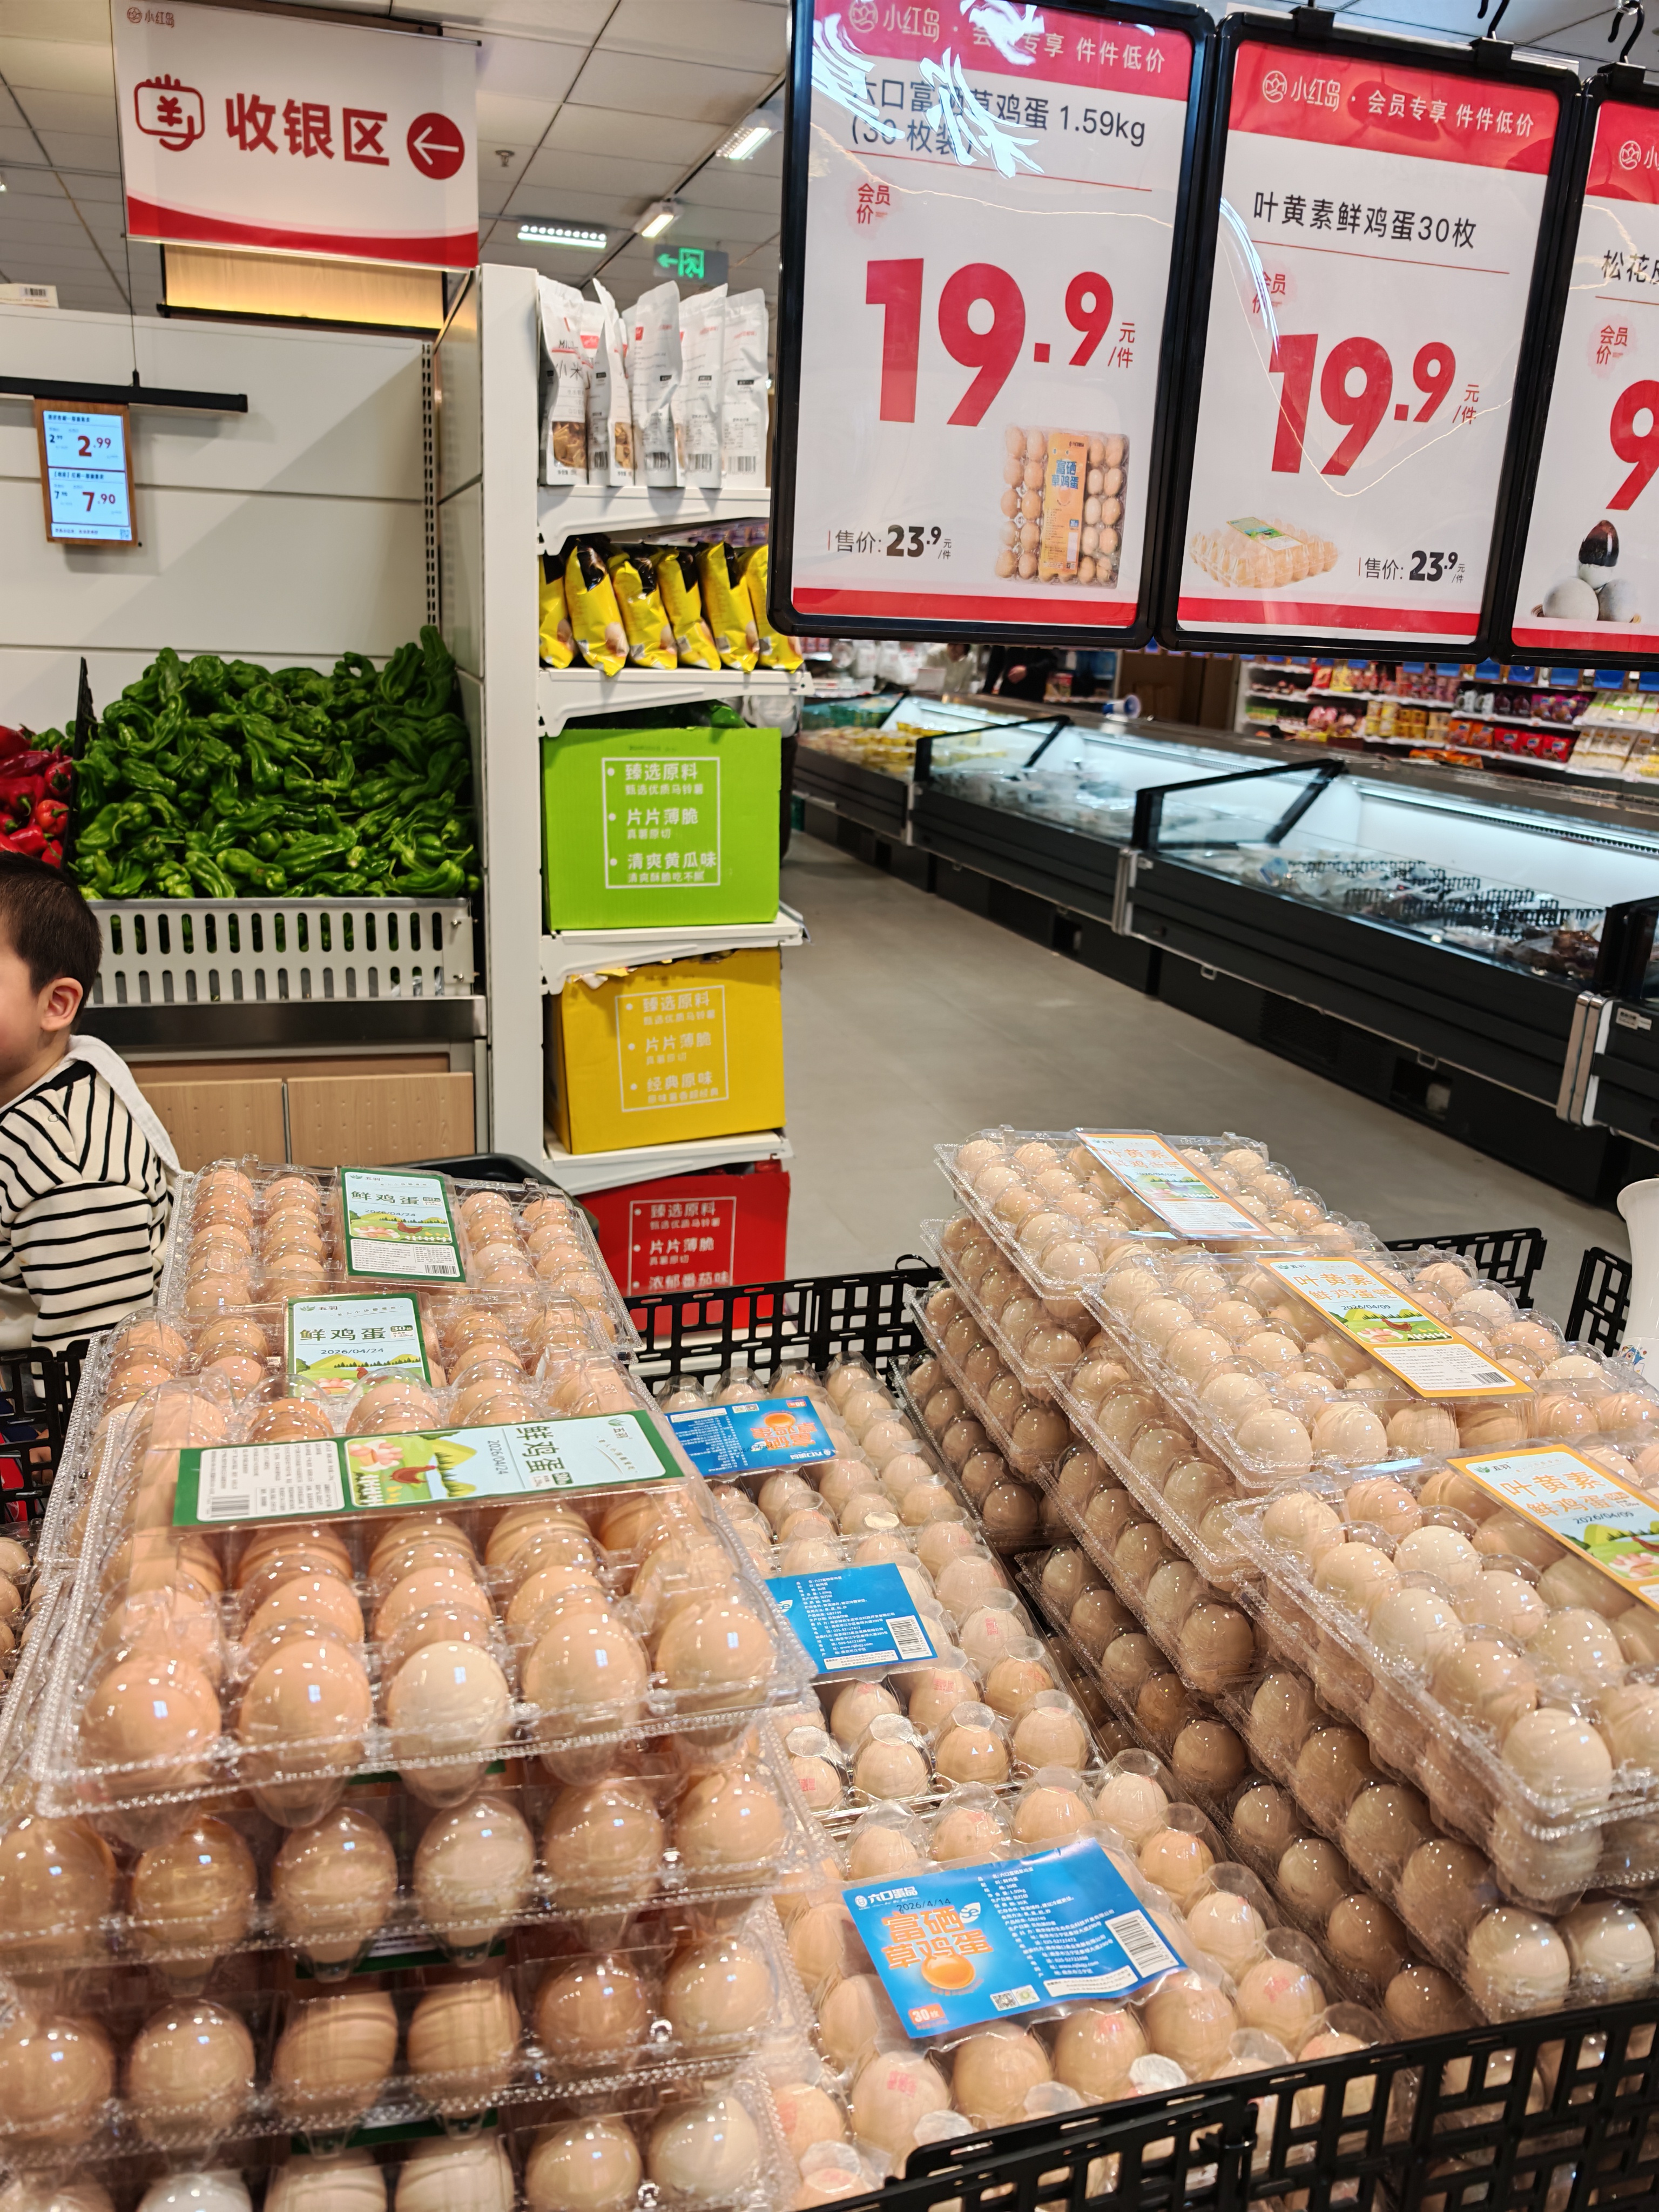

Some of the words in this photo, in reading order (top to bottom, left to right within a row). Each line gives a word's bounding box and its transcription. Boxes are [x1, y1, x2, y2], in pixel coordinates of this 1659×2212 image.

[144, 9, 174, 28] 小红岛
[883, 4, 940, 43] 小红岛
[973, 21, 1064, 58] 会专享
[1076, 36, 1166, 74] 件件低价
[1290, 78, 1340, 113] 小红岛
[1368, 90, 1447, 124] 会员专享
[1455, 103, 1534, 138] 件件低价
[225, 92, 390, 167] 收银区
[1059, 103, 1147, 147] 1.59kg
[1644, 145, 1659, 170] 小
[858, 183, 891, 207] 会员
[856, 204, 873, 225] 价
[1253, 191, 1476, 249] 叶黄素鲜鸡蛋30枚
[865, 258, 1113, 427] 19.9
[1120, 322, 1136, 342] 元
[1600, 324, 1628, 347] 会员
[1107, 346, 1134, 369] /件
[1596, 345, 1611, 365] 价
[1464, 383, 1480, 402] 元
[1268, 333, 1456, 477] 19.9
[885, 525, 942, 557] 23.9
[1408, 550, 1459, 582] 23.9
[625, 763, 698, 781] 臻选原料
[626, 807, 699, 826] 片片薄脆
[628, 852, 717, 870] 清爽黄瓜味
[643, 990, 710, 1013] 臻选原料
[645, 1031, 711, 1053] 片片薄脆
[647, 1070, 713, 1092] 经典原味
[351, 1191, 420, 1205] 鲜鸡蛋
[650, 1201, 716, 1219] 臻选原料
[649, 1237, 714, 1255] 片片薄脆
[1292, 1272, 1378, 1288] 叶黄素
[1309, 1288, 1376, 1301] 鲜鸡蛋
[299, 1327, 387, 1341] 鲜鸡蛋
[487, 1439, 510, 1475] 2026/04/24
[515, 1425, 565, 1473] 鲜鸡蛋
[1500, 1471, 1607, 1498] 叶黄素
[1526, 1494, 1612, 1518] 鲜鸡蛋
[1573, 1511, 1634, 1525] 2026/04/09
[867, 1886, 918, 1904] 六口蛋品
[896, 1898, 951, 1911] 2026/4/14
[881, 1905, 965, 1943] 富硒
[881, 1928, 994, 1969] 草鸡蛋
